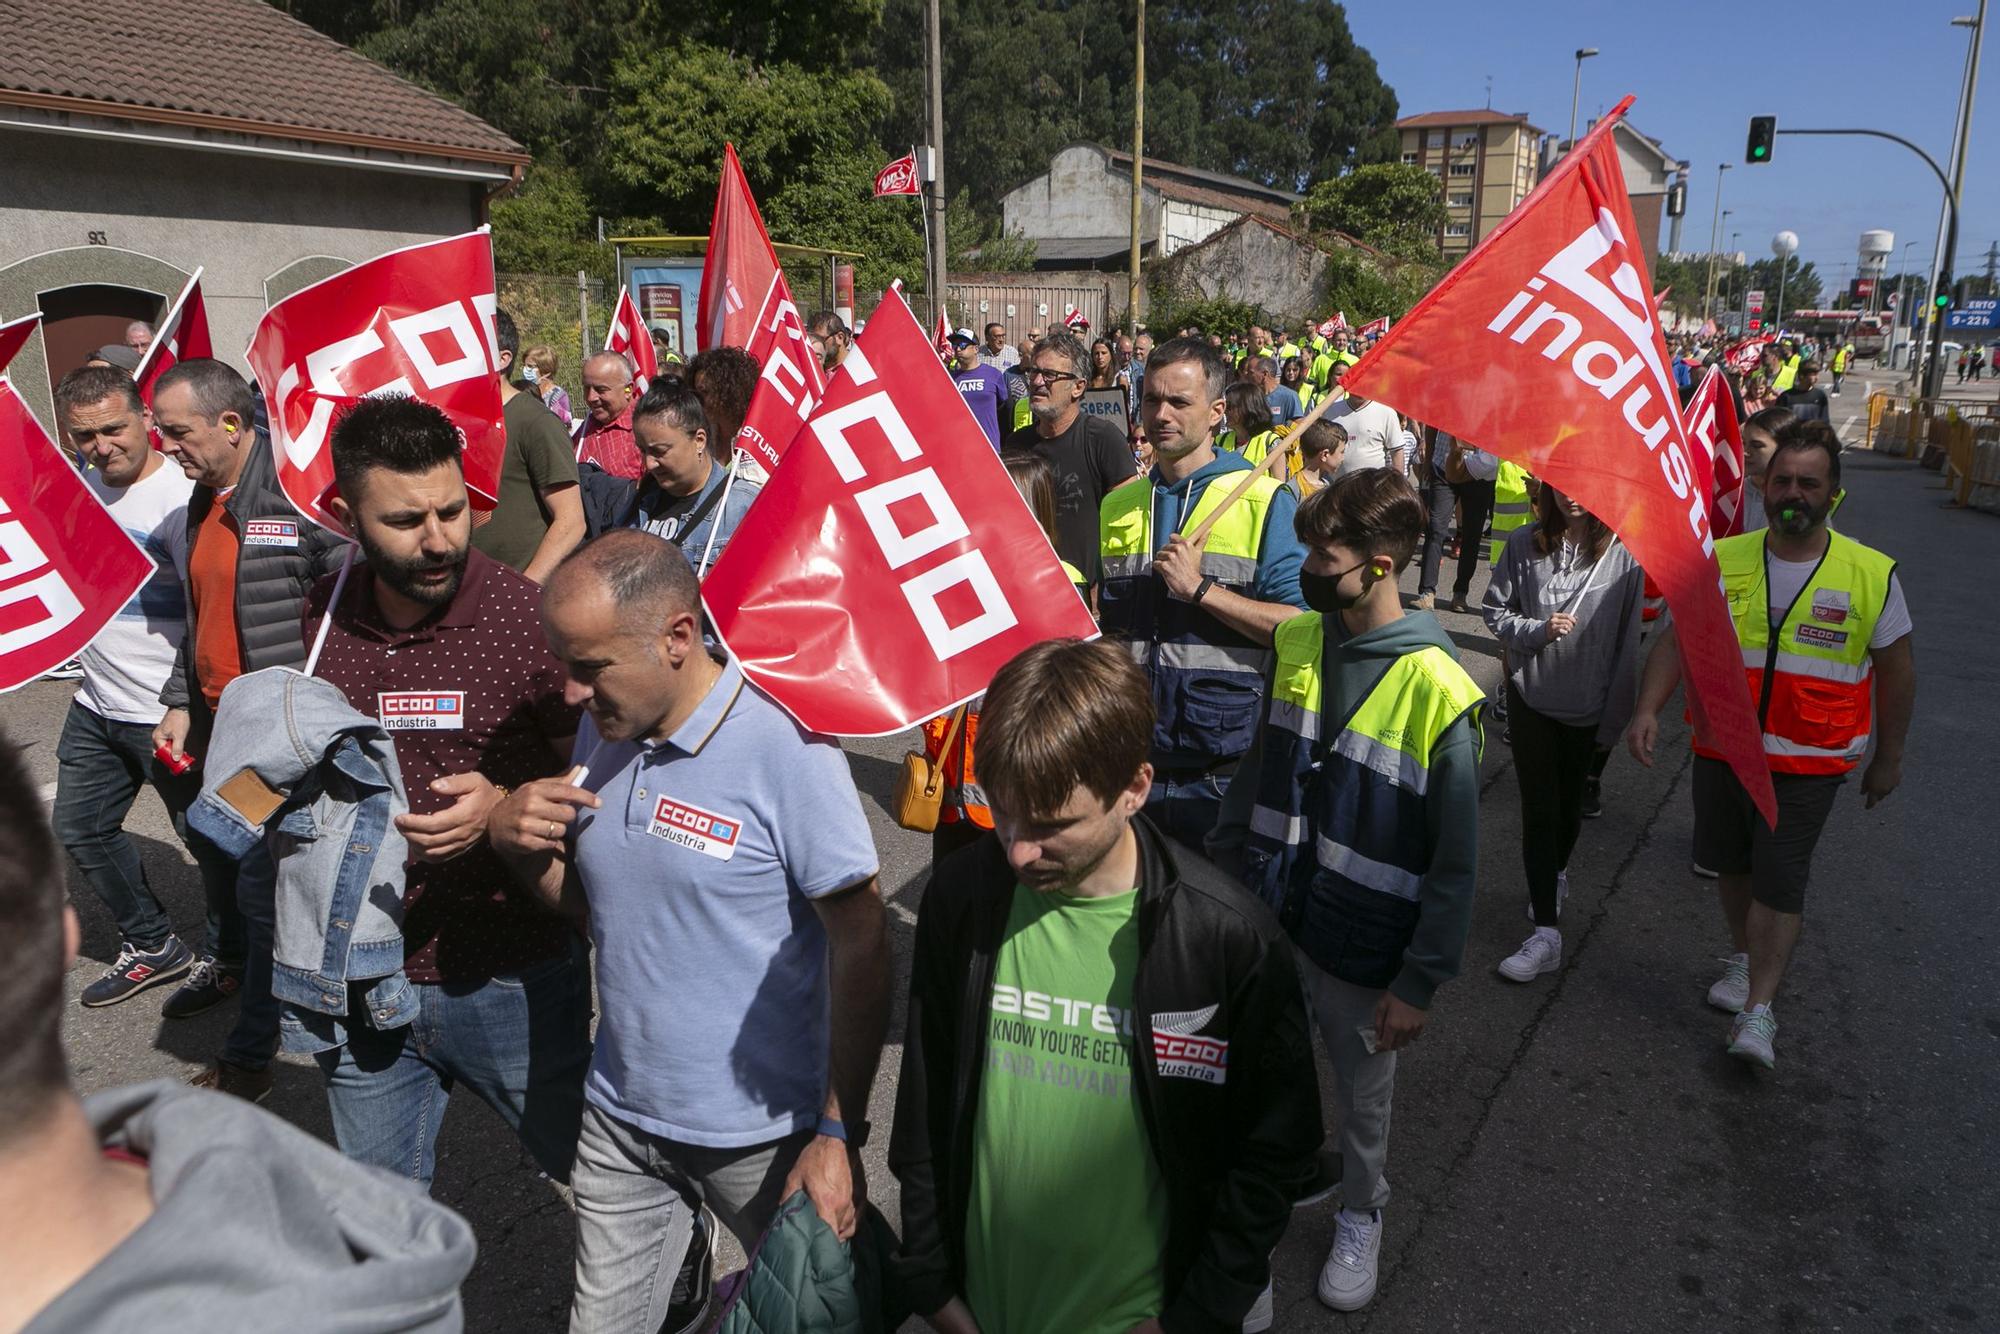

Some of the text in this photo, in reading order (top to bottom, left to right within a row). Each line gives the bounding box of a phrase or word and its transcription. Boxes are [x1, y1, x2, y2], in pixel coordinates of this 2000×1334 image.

[88, 231, 107, 245] 93
[1080, 401, 1122, 415] SOBRA
[247, 524, 281, 533] CCOO
[1800, 626, 1834, 639] CCOO
[1796, 636, 1832, 648] industria
[385, 698, 434, 711] CCOO
[384, 717, 437, 728] industria
[660, 804, 711, 832] CCOO
[652, 822, 706, 851] industria
[993, 1018, 1036, 1048] KNOW
[1040, 1028, 1089, 1059] YOU'RE
